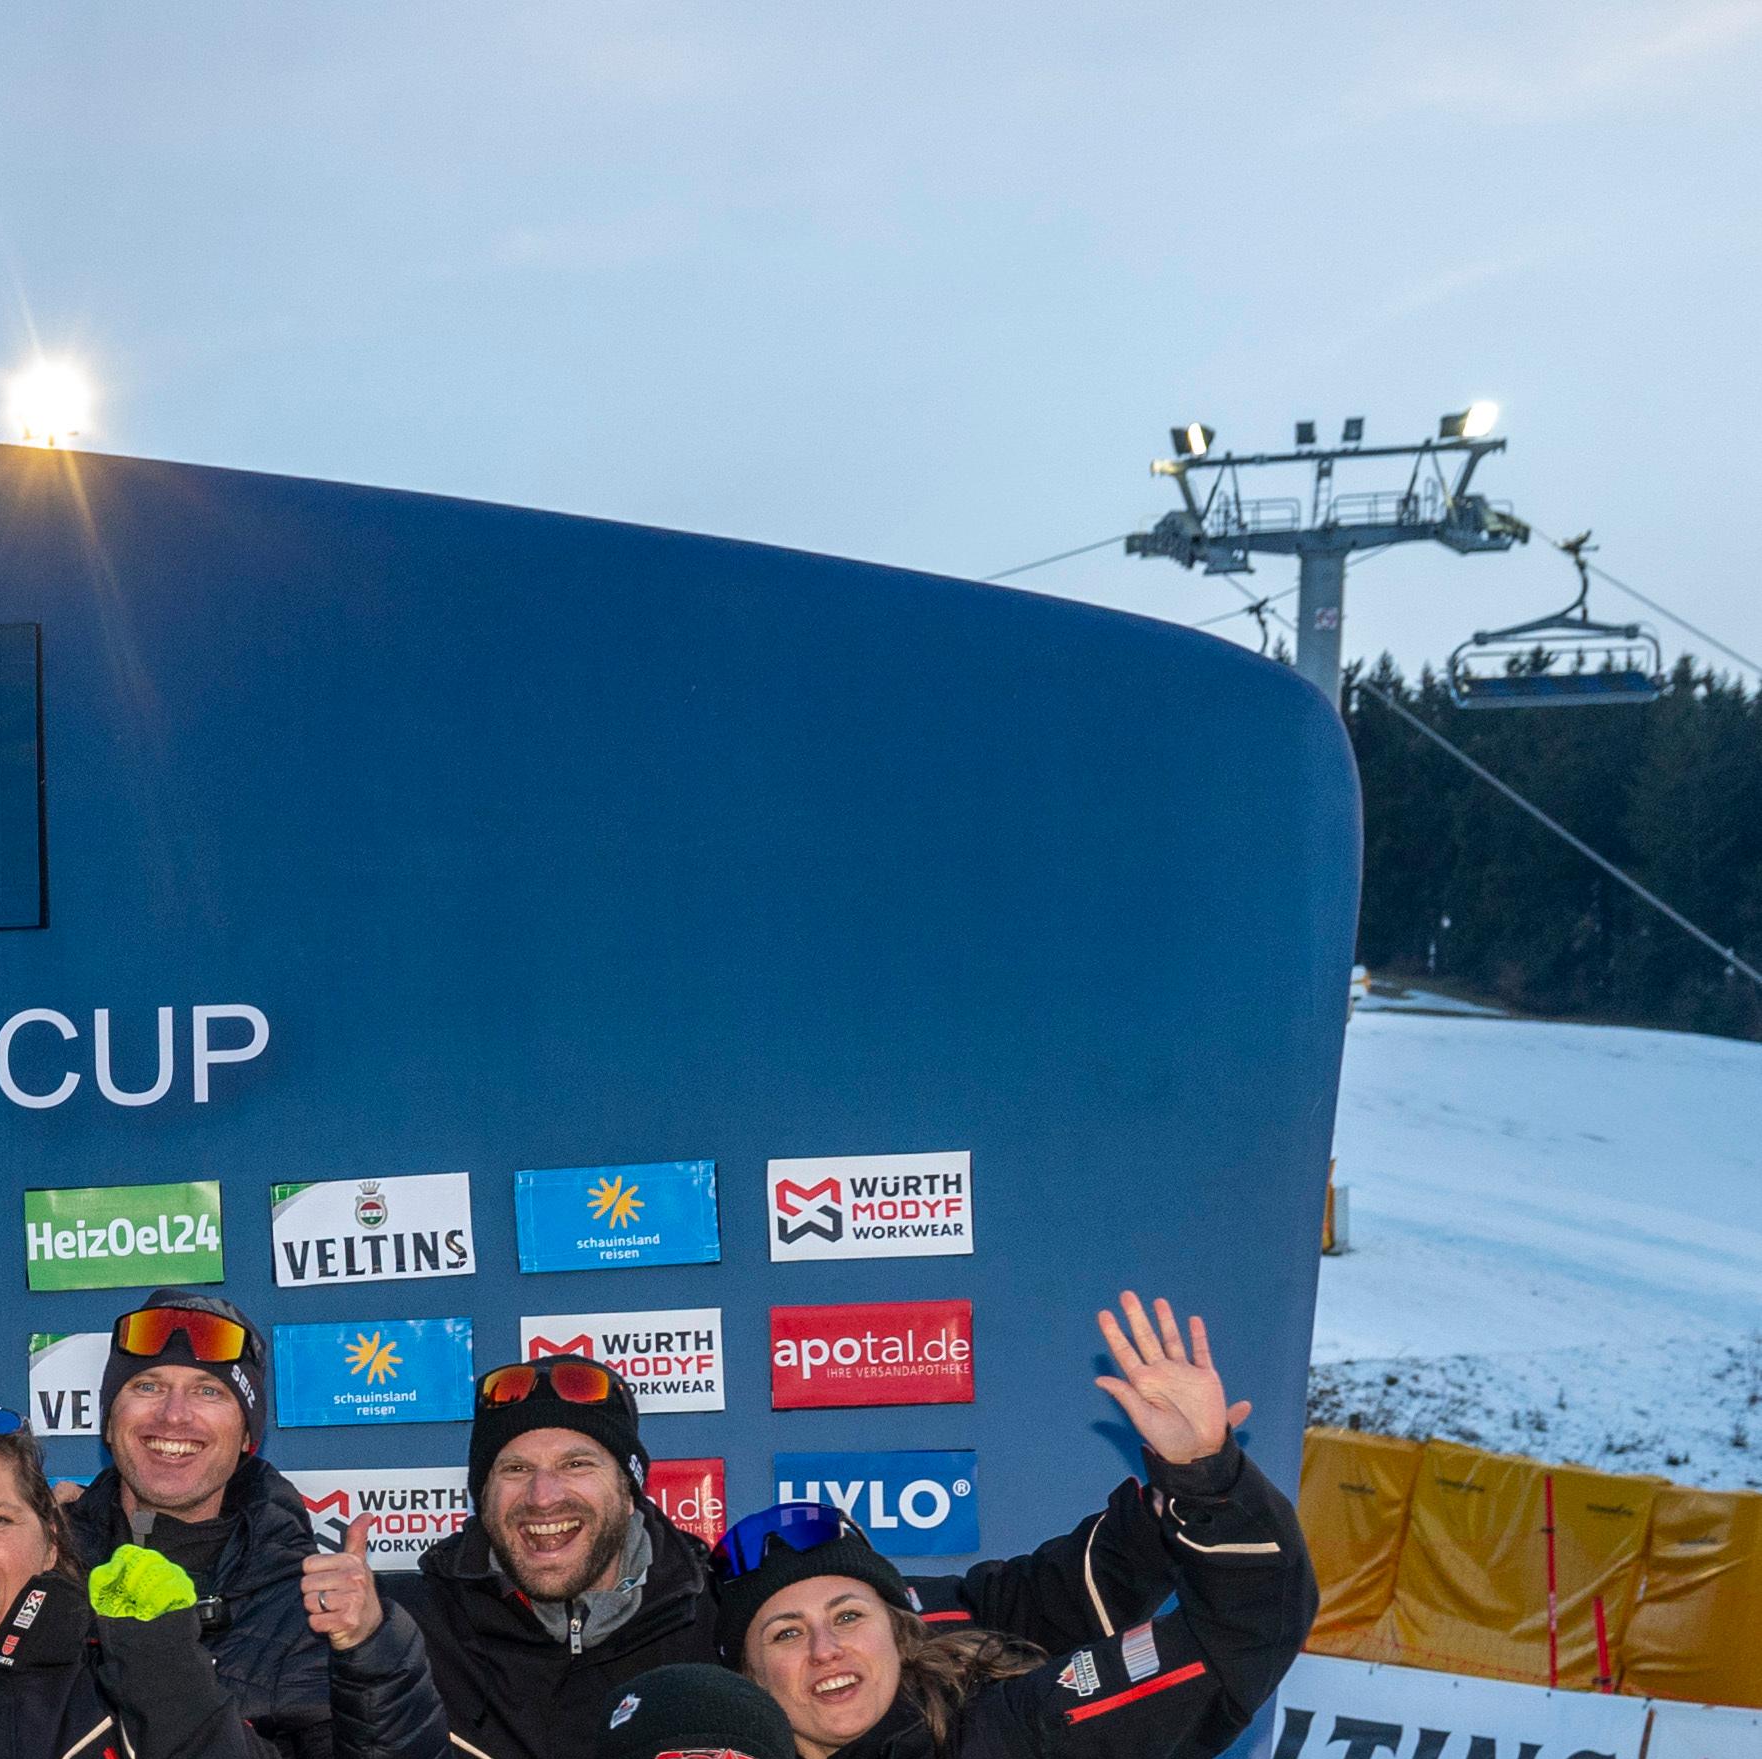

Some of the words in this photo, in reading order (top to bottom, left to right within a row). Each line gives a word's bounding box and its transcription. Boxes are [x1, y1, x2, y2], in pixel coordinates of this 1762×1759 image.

[852, 1198, 963, 1221] MODYF
[27, 1215, 219, 1261] HeizOel24
[853, 1223, 964, 1239] WORKWEAR
[576, 1233, 660, 1249] schauinsland
[282, 1229, 468, 1281] VELTINS
[599, 1248, 640, 1260] reisen
[774, 1328, 969, 1380] apotal.de
[826, 1366, 852, 1378] IHRE
[855, 1362, 970, 1378] VERSANDAPOTHEKE
[628, 1379, 715, 1396] ORKWEAR
[333, 1390, 417, 1405] schauinsland
[356, 1404, 396, 1416] reisen
